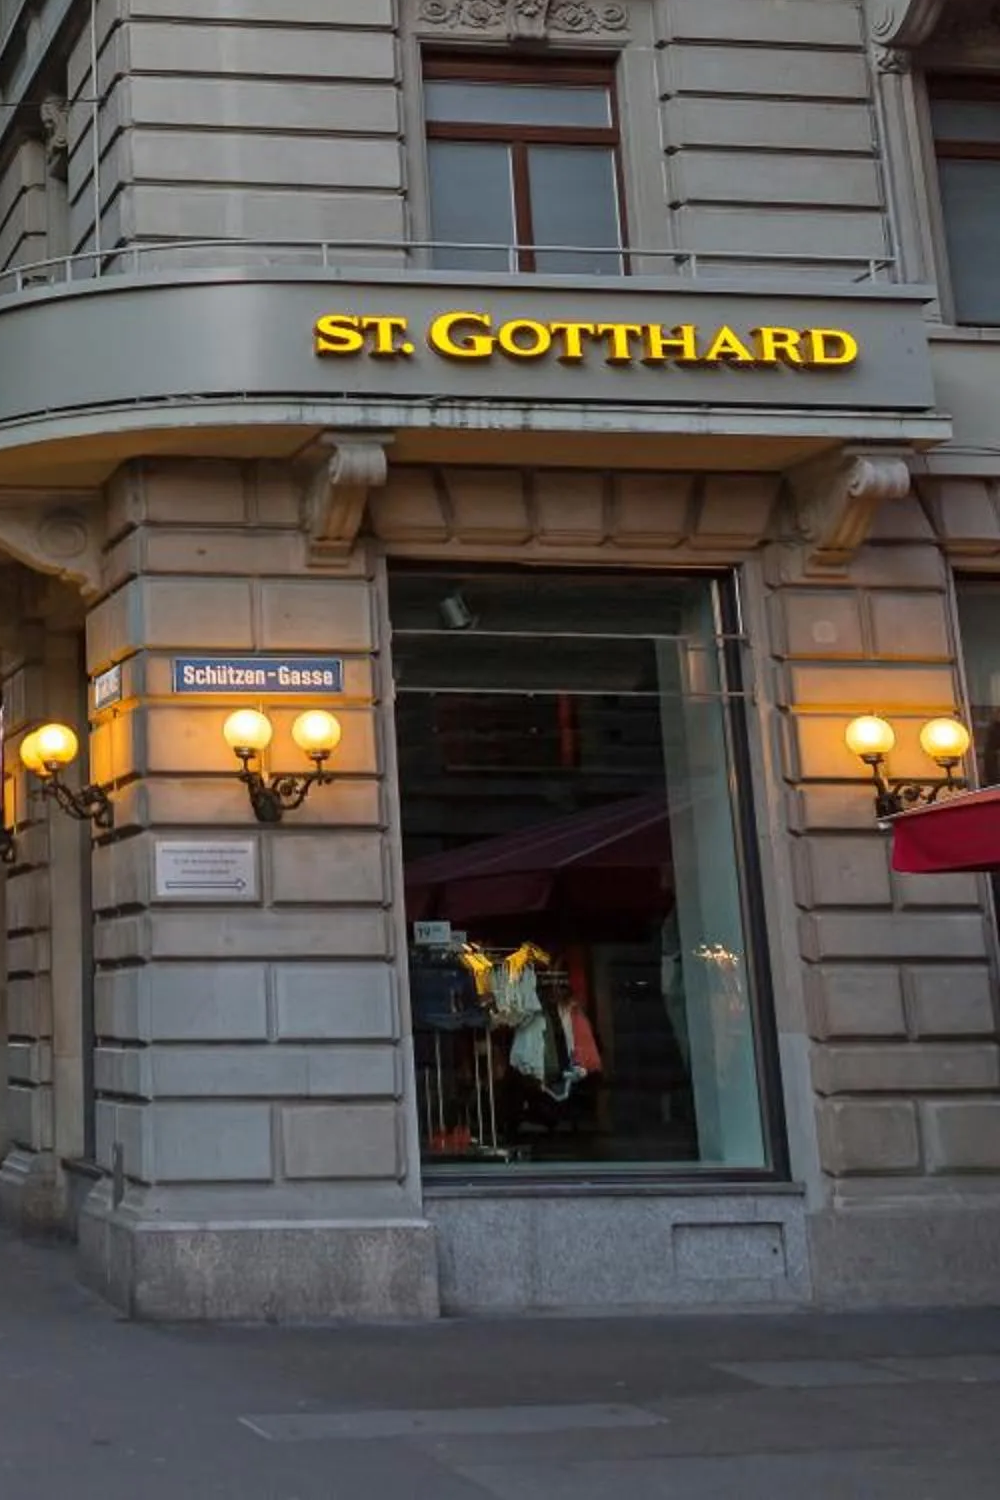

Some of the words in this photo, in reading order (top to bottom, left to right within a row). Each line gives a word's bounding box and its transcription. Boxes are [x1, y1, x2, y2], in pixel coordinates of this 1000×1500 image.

[314, 313, 416, 355] ST.
[427, 310, 859, 367] GOTTHARD
[182, 664, 334, 687] Schützen-Gasse
